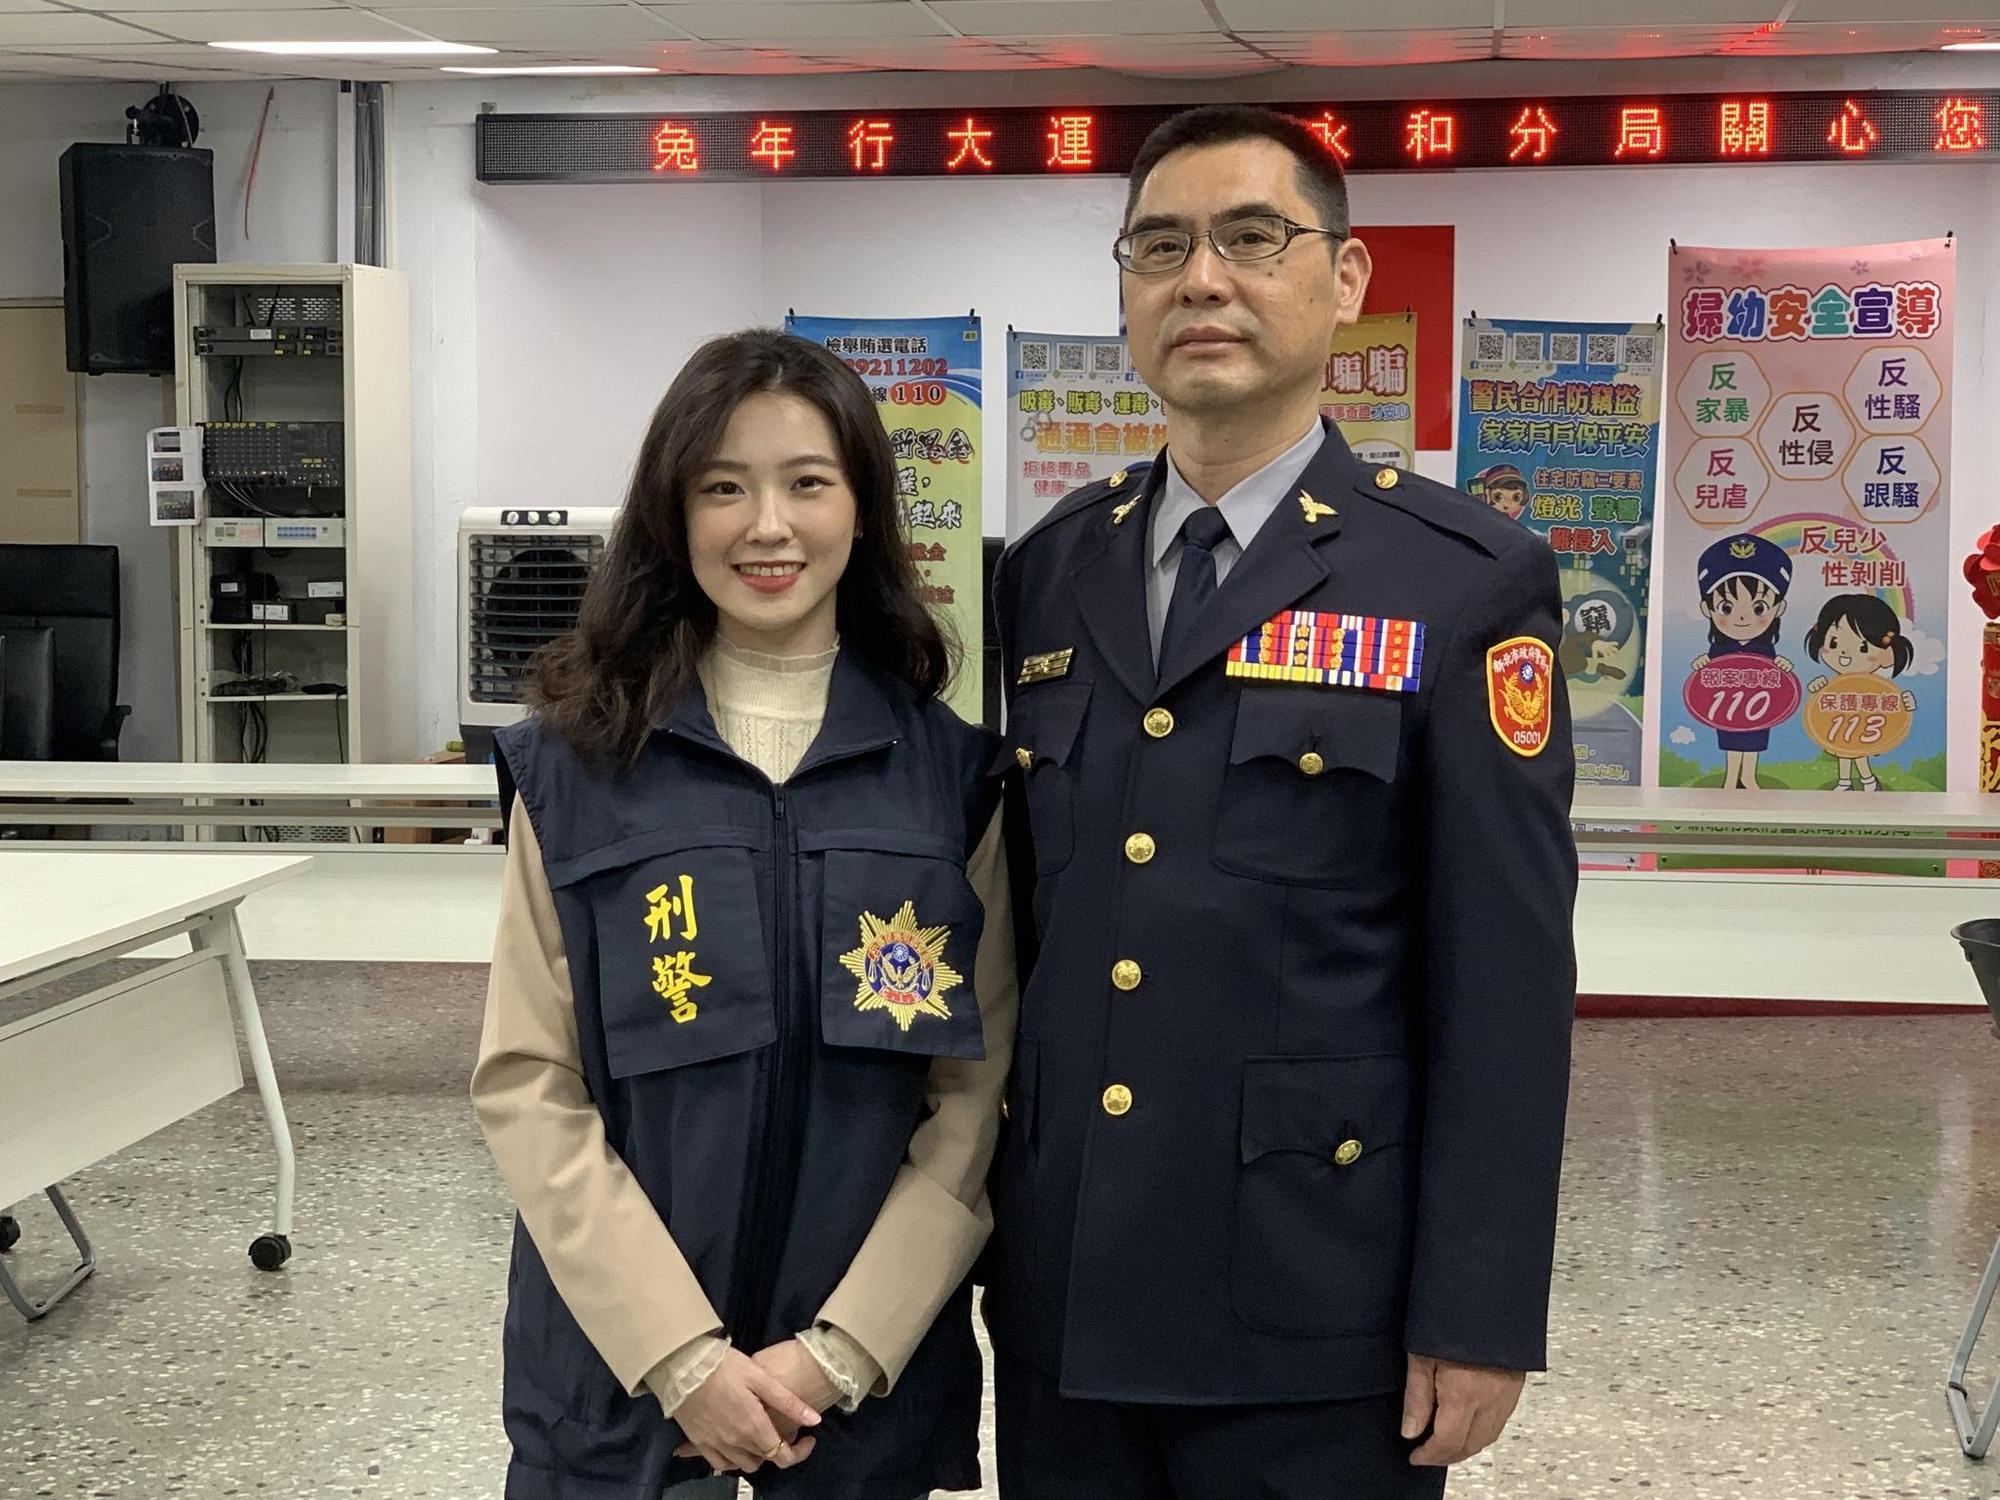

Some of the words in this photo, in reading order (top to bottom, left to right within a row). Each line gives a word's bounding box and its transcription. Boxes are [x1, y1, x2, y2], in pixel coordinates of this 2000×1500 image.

[653, 115, 1093, 171] 兔年行大運
[1684, 284, 1937, 340] 婦幼安全宣導
[1320, 344, 1408, 396] 騙騙
[1708, 362, 1737, 391] 反
[1878, 358, 1908, 387] 反
[895, 386, 941, 401] 110
[1020, 390, 1167, 416] 吸毒、販毒、運毒、
[1471, 380, 1640, 416] 警民合作防竊盜
[1865, 394, 1920, 420] 性騷
[1696, 397, 1749, 423] 家暴
[1792, 404, 1822, 433] 反
[1480, 420, 1651, 455] 家家戶戶保平安
[1707, 449, 1736, 477] 反
[1779, 440, 1833, 466] 性侵
[1876, 446, 1906, 475] 反
[1532, 495, 1582, 520] 燈光
[1695, 484, 1748, 509] 兒虐
[1863, 483, 1919, 508] 跟騷
[1800, 526, 1886, 553] 反兒少
[1822, 561, 1905, 587] 性剝削
[1702, 669, 1781, 688] 報案專線
[1707, 691, 1770, 721] 110
[1820, 693, 1899, 711] 保護專線
[1828, 715, 1886, 743] 113
[644, 874, 712, 1025] 刑警
